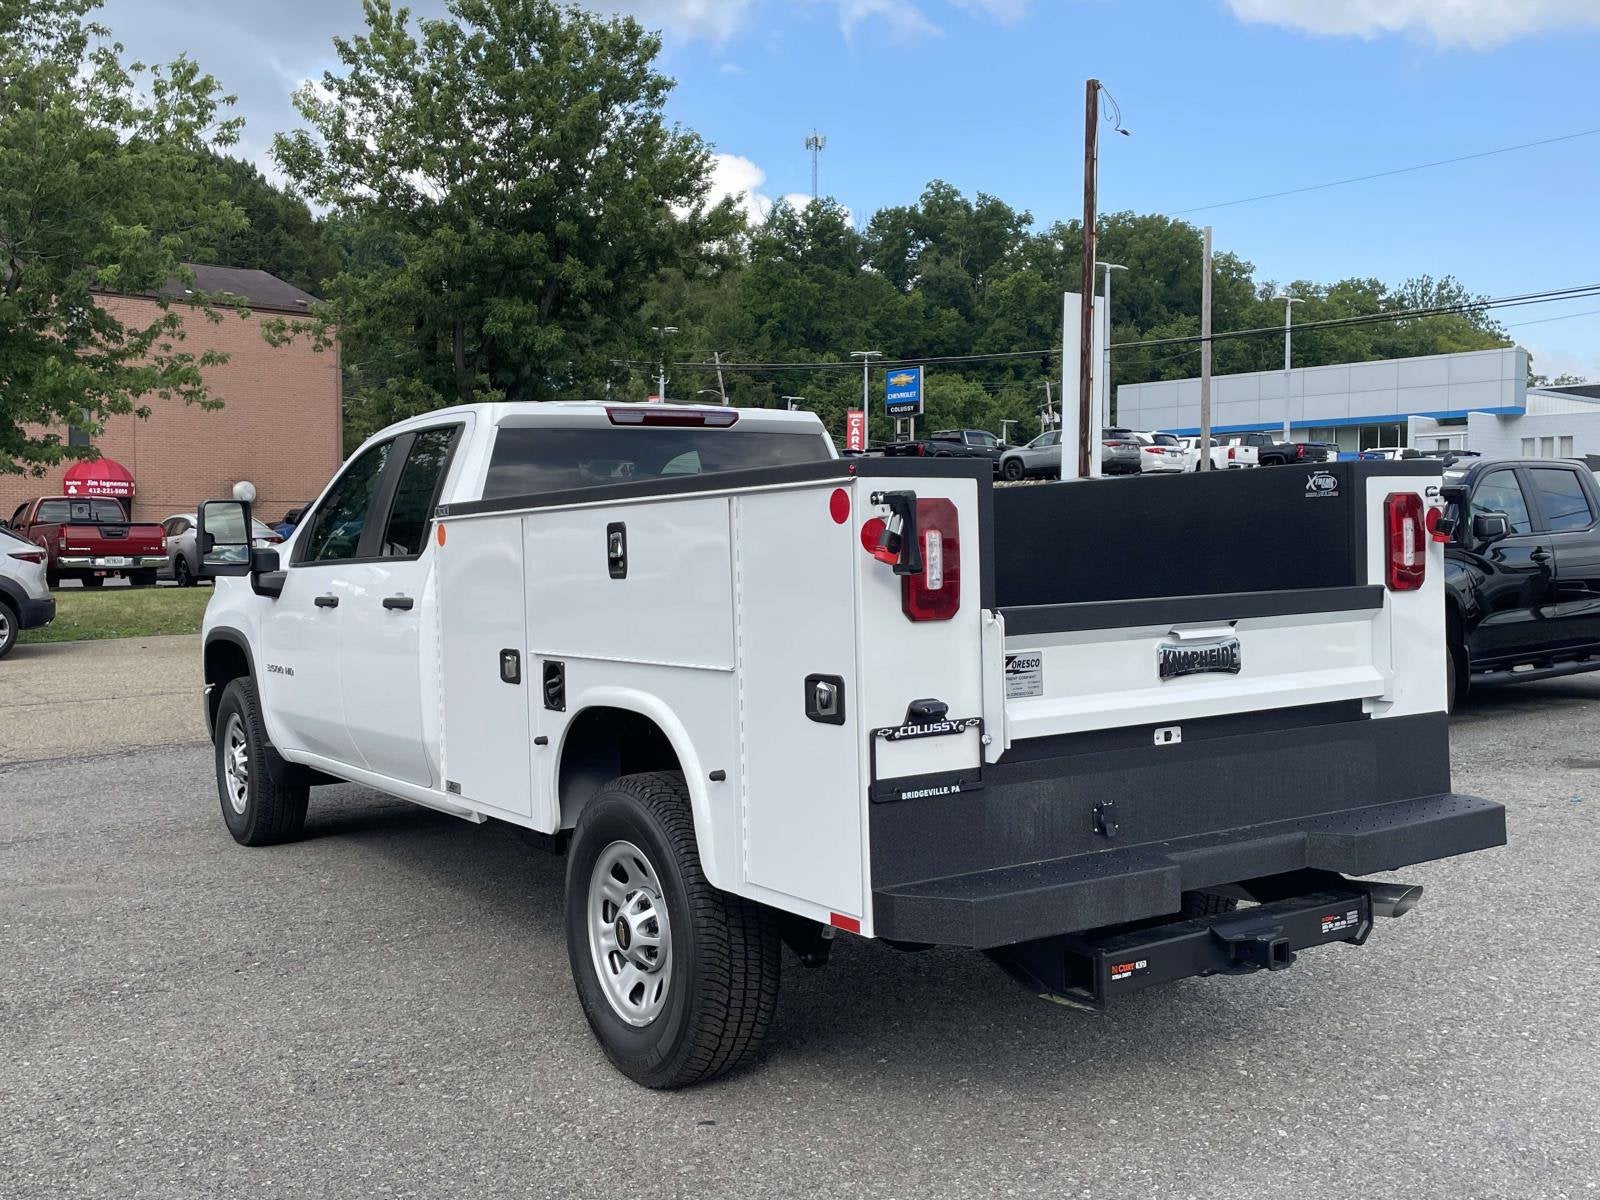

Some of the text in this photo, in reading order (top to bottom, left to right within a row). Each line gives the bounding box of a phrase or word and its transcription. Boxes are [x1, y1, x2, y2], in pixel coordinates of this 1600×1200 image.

[887, 391, 917, 400] CHEVROLET
[890, 405, 914, 413] COLUSSY
[851, 418, 861, 451] CARS
[1160, 642, 1238, 677] KNAPHEIDE
[284, 667, 295, 676] HD
[900, 721, 960, 736] COLUSSY
[951, 785, 960, 794] PA
